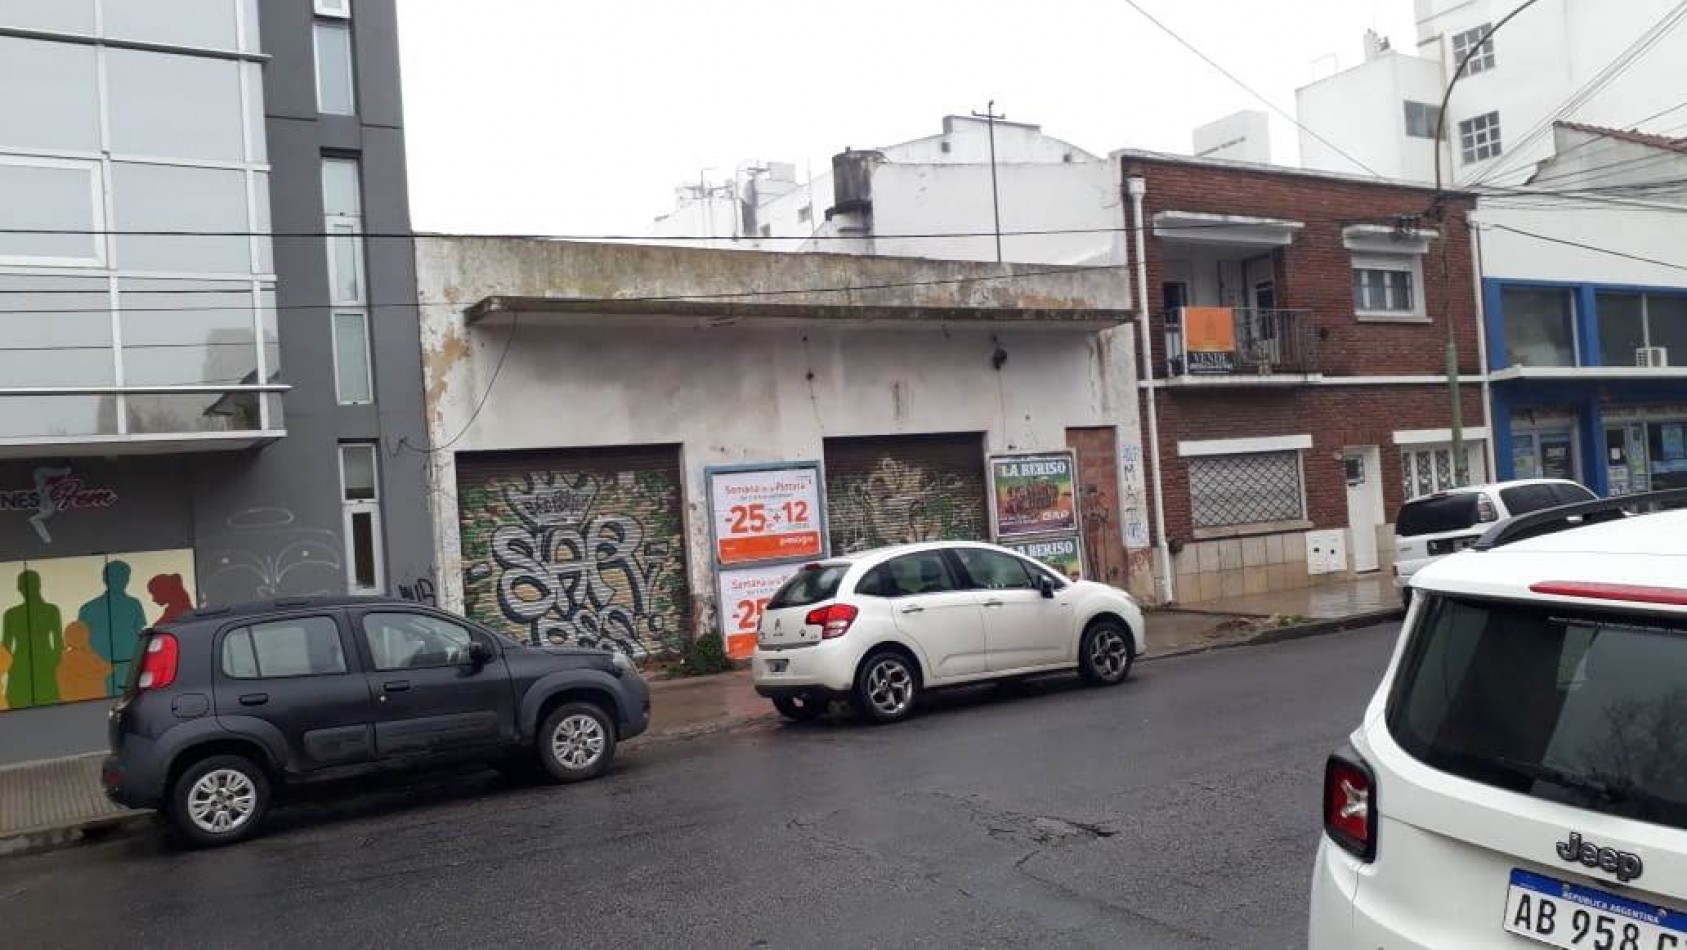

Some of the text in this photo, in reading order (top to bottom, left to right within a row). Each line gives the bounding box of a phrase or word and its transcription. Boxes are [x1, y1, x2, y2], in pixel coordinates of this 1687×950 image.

[1194, 352, 1229, 363] VENDE
[1001, 461, 1067, 476] LA BERISO
[1029, 541, 1073, 557] BERISO
[1556, 831, 1643, 882] Jeep
[1514, 893, 1557, 935] AB
[1571, 909, 1640, 950] 958
[1609, 902, 1661, 924] ARGENTINA
